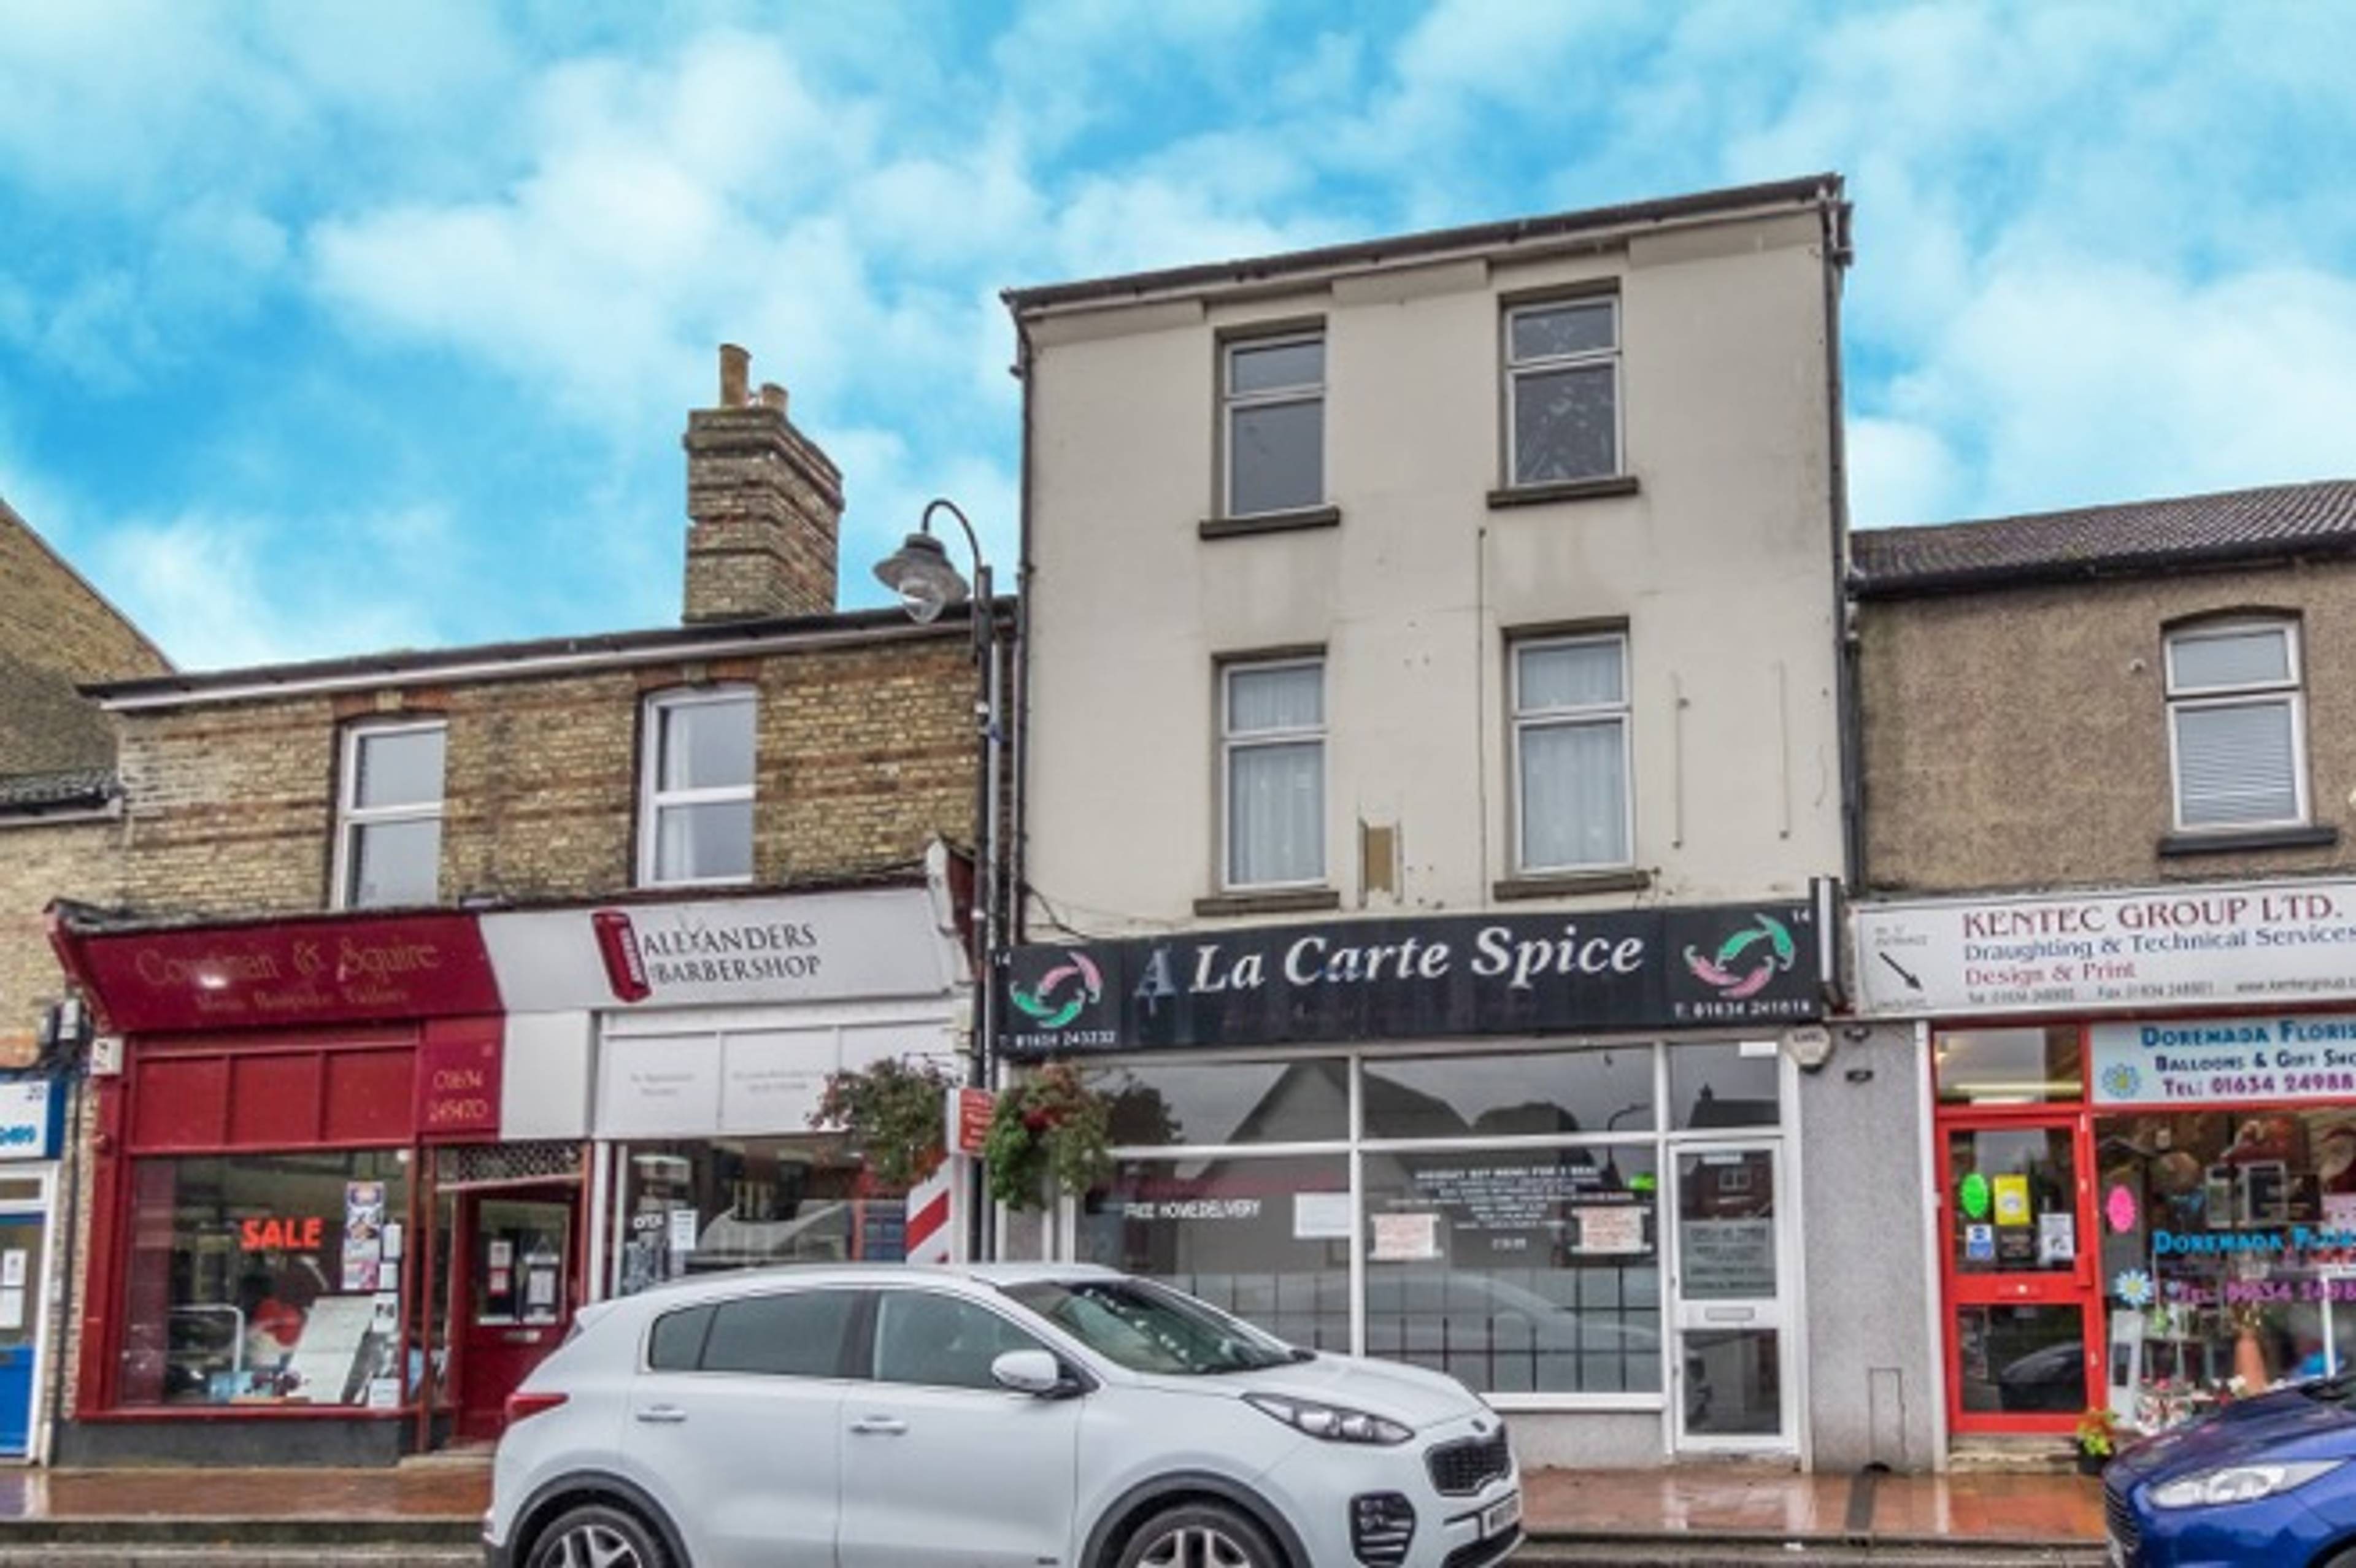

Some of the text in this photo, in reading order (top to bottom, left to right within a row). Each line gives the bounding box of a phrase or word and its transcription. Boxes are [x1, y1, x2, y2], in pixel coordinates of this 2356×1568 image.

[1963, 895, 2343, 938] KENTEC GROUP LTD.
[644, 922, 818, 956] ALEXANDERS
[1965, 940, 2093, 963] Draughting
[2101, 937, 2122, 953] &
[2130, 931, 2247, 952] Technical
[657, 955, 821, 984] BARBERSHOP
[1189, 945, 1265, 993] La
[1285, 936, 1451, 986] Carte
[1471, 924, 1645, 990] Spice
[1965, 962, 2136, 987] Design & Print
[2254, 1052, 2268, 1068] &
[2211, 1075, 2275, 1094] 01634
[240, 1217, 324, 1251] SALE
